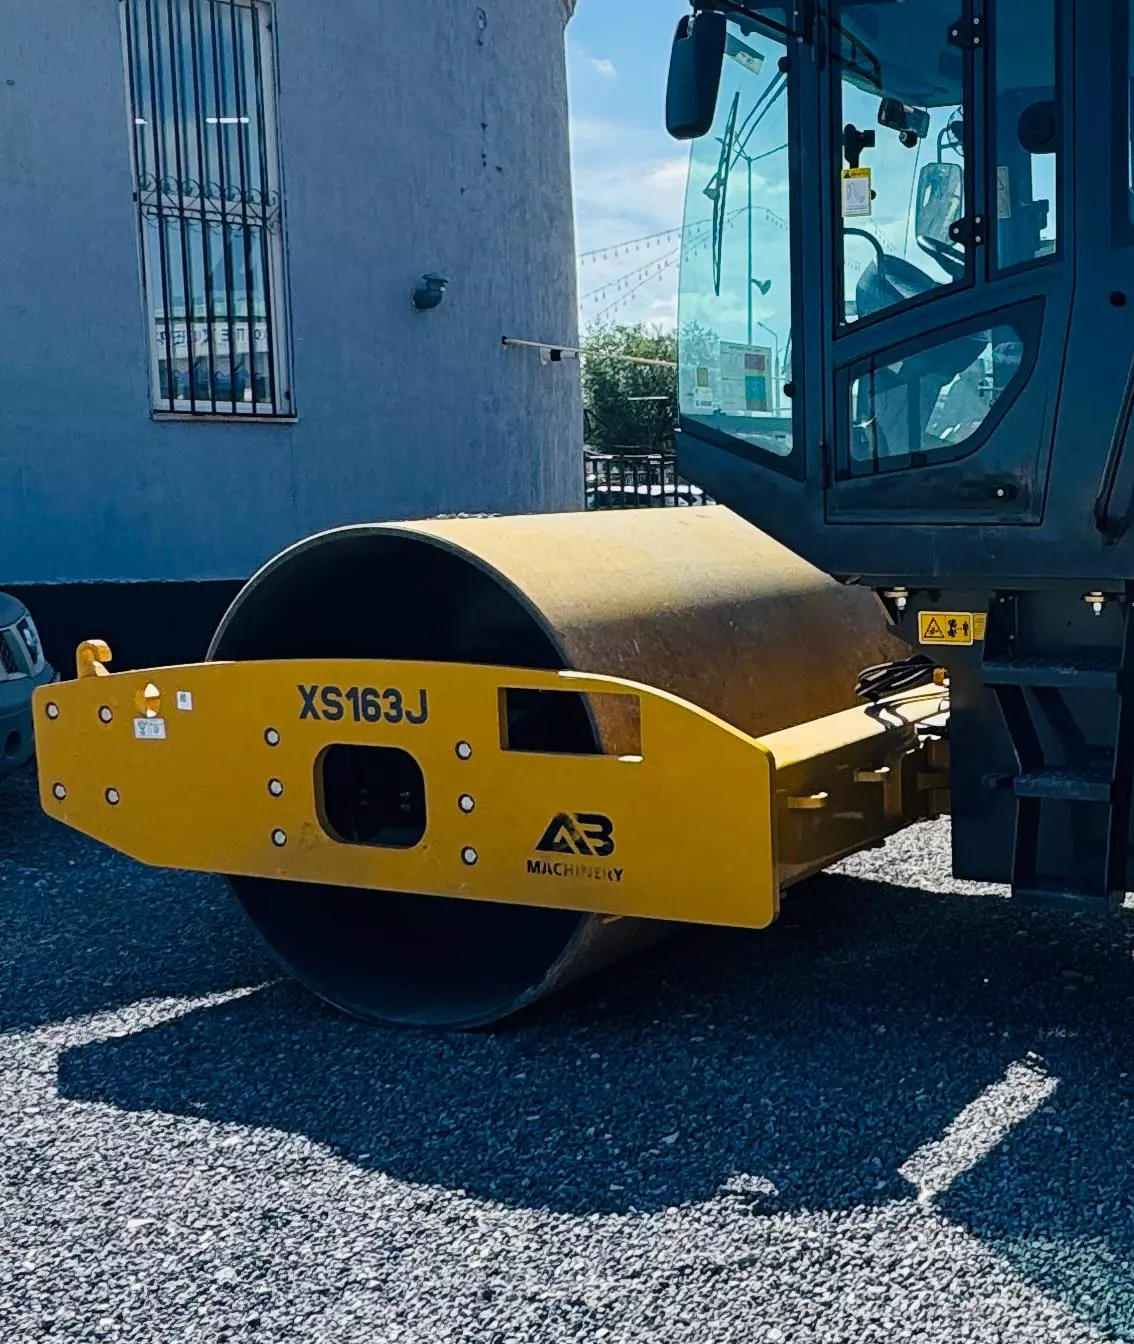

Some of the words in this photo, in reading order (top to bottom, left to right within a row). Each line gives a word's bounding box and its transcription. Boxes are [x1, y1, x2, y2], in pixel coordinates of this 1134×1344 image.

[297, 685, 428, 724] XS163J
[535, 812, 615, 856] AB
[527, 859, 624, 882] MACHINERY
